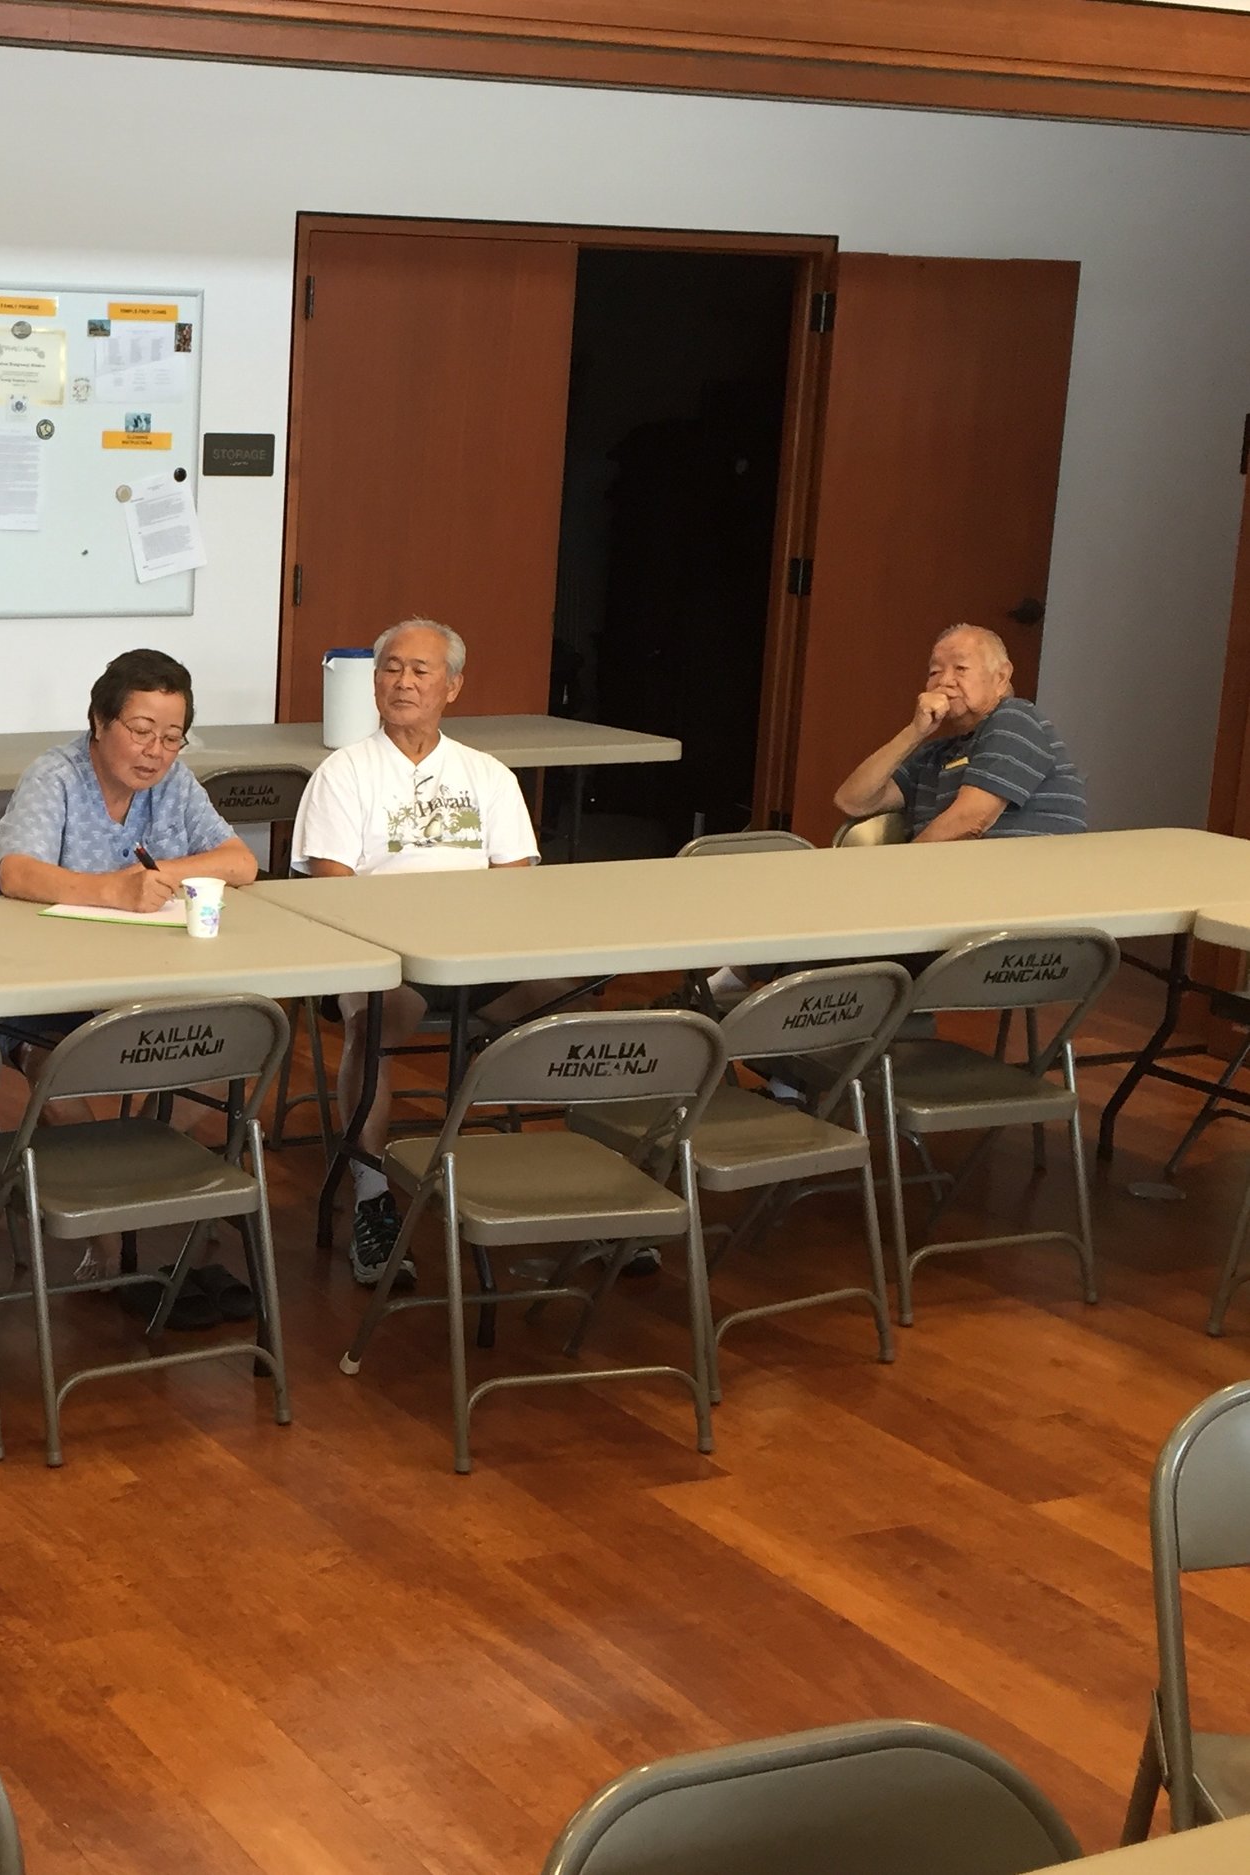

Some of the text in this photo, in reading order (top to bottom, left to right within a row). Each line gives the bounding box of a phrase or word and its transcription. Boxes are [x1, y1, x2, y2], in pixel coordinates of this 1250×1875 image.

[213, 448, 267, 460] STORAGE
[229, 784, 275, 797] KAILUA
[218, 795, 281, 808] HONGANJI
[1001, 952, 1063, 969] KAILUA
[983, 966, 1070, 984] HONGANJI
[799, 990, 858, 1013] KAILUA
[781, 1003, 865, 1031] HONGANJI
[137, 1024, 214, 1046] KAILUA
[119, 1038, 225, 1064] HONGANJI
[566, 1042, 647, 1060] KAILUA
[547, 1058, 659, 1078] HONGANJI
